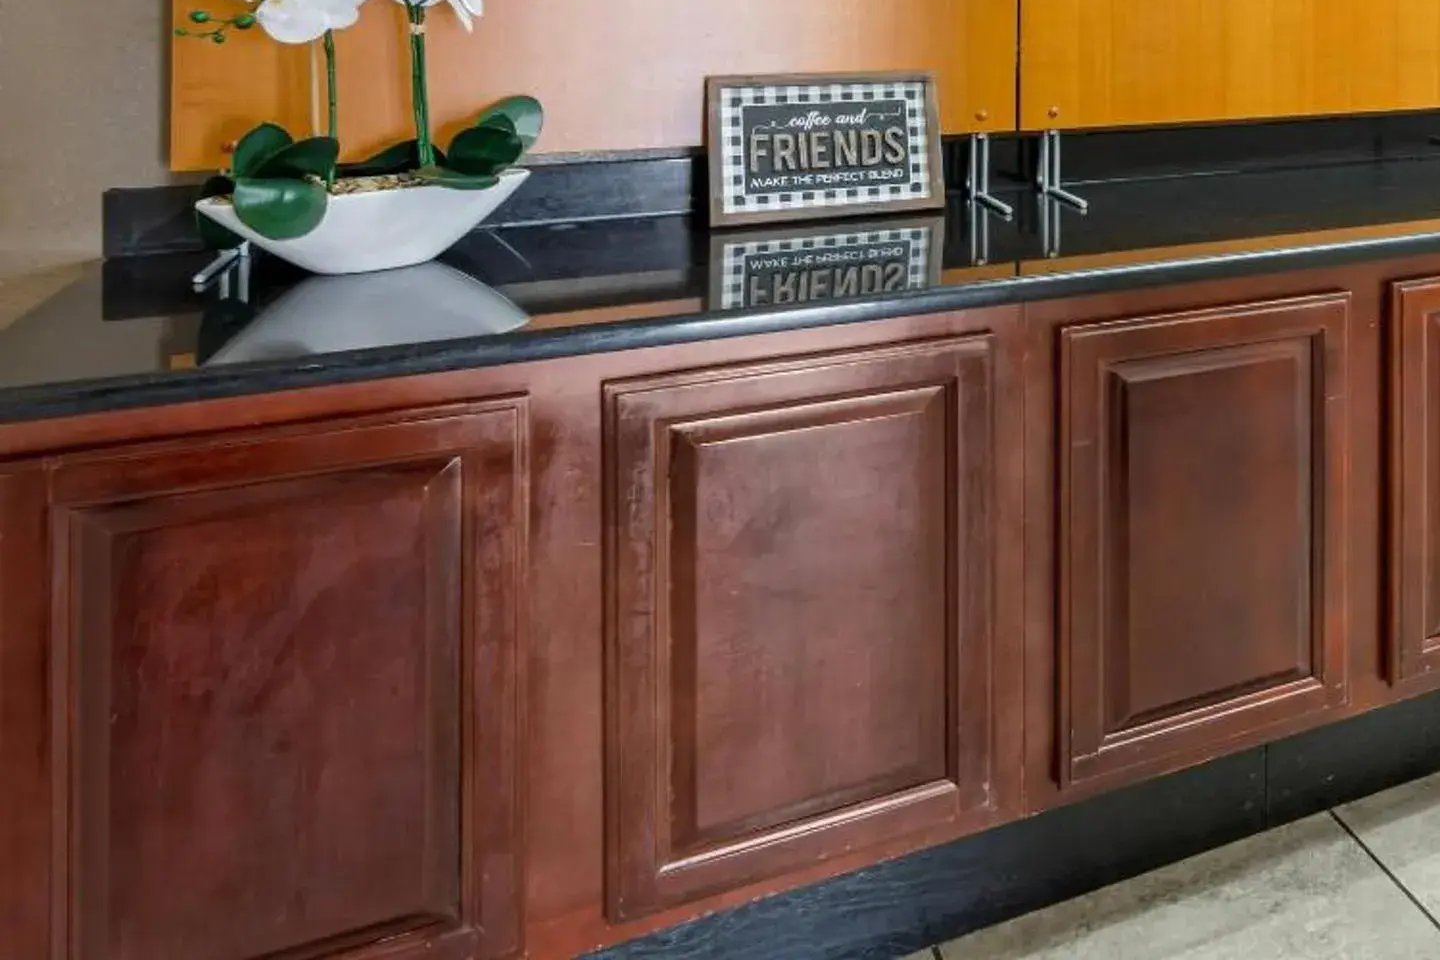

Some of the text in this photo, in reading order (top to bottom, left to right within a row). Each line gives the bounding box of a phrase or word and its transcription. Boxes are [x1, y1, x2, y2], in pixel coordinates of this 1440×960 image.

[788, 108, 867, 131] coffee and
[750, 126, 905, 173] FRIENDS
[750, 176, 787, 188] MAKE
[792, 174, 815, 185] THE
[816, 170, 866, 184] PERFECT
